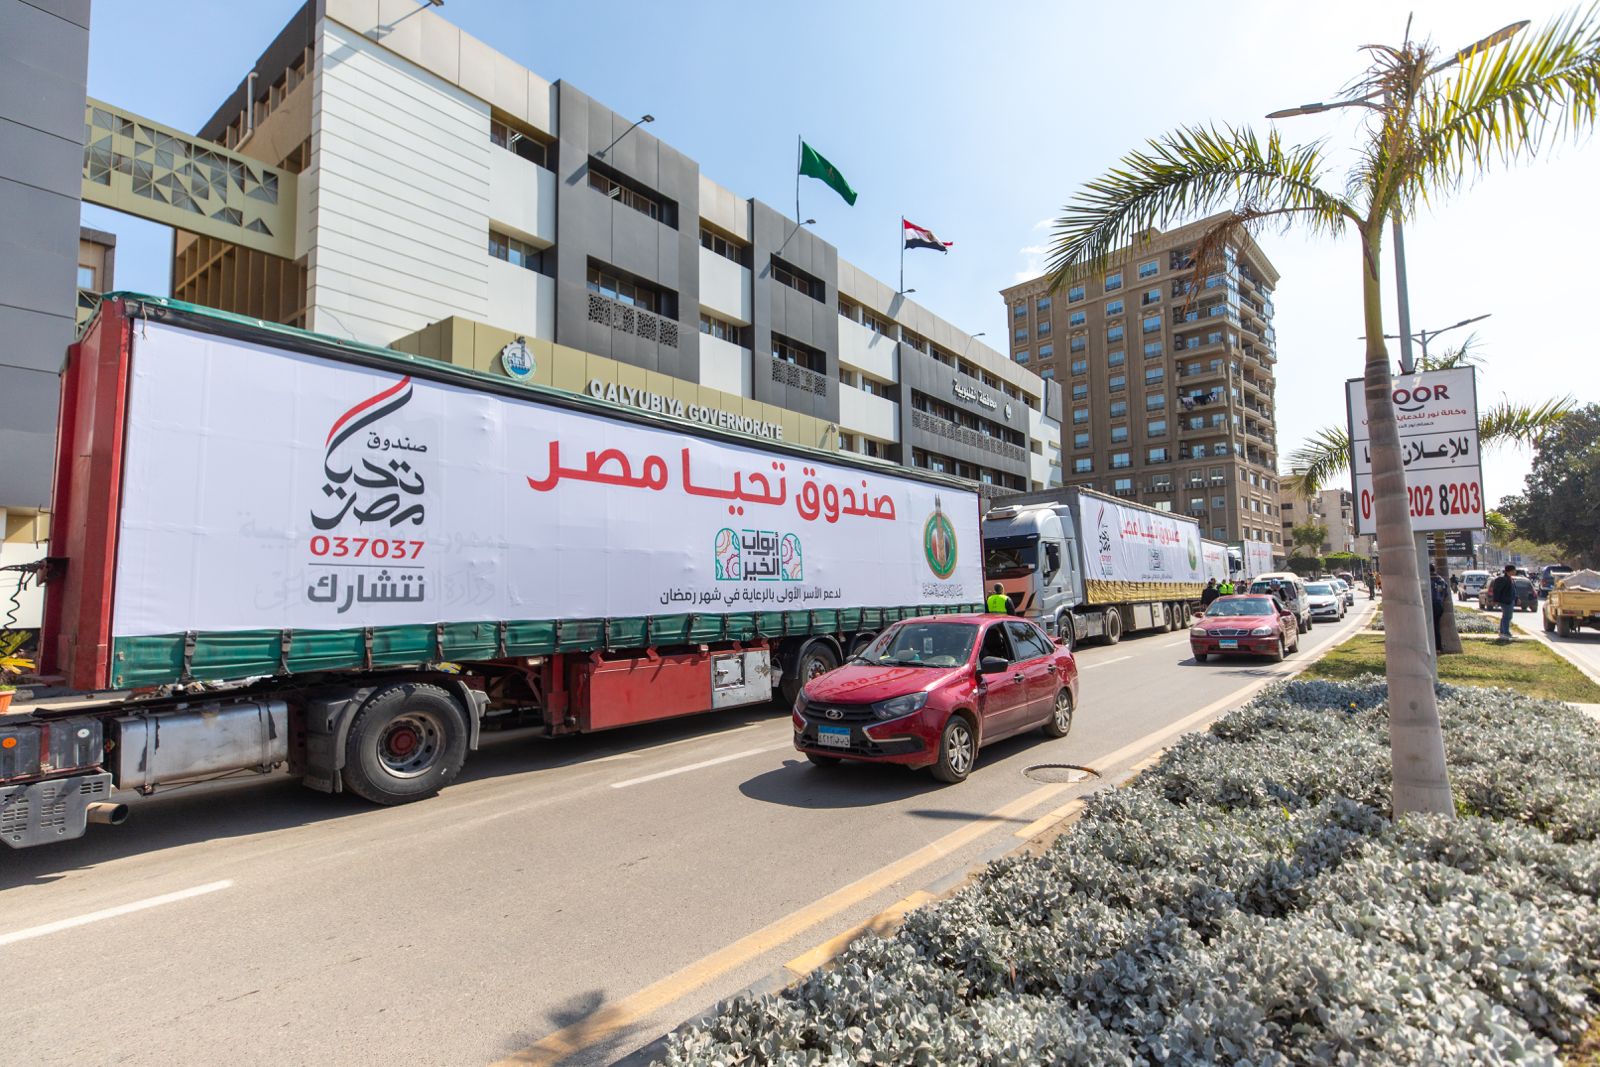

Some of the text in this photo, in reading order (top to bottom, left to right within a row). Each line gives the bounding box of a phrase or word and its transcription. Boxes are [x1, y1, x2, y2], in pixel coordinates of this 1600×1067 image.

[1392, 384, 1450, 405] OOR
[590, 379, 784, 440] QALYUBIYA GOVERNORATE
[1441, 409, 1467, 417] وكالة
[367, 431, 428, 453] صندوق
[526, 440, 897, 525] صندوق تحيا مصر
[1439, 481, 1482, 515] 8203
[309, 535, 425, 560] 037037
[741, 530, 780, 556] أبواب
[742, 556, 780, 582] الخير
[307, 570, 425, 614] نتشارك
[660, 587, 842, 607] لدعم الأسر الأولى بالرعاية في شهر رمضان
